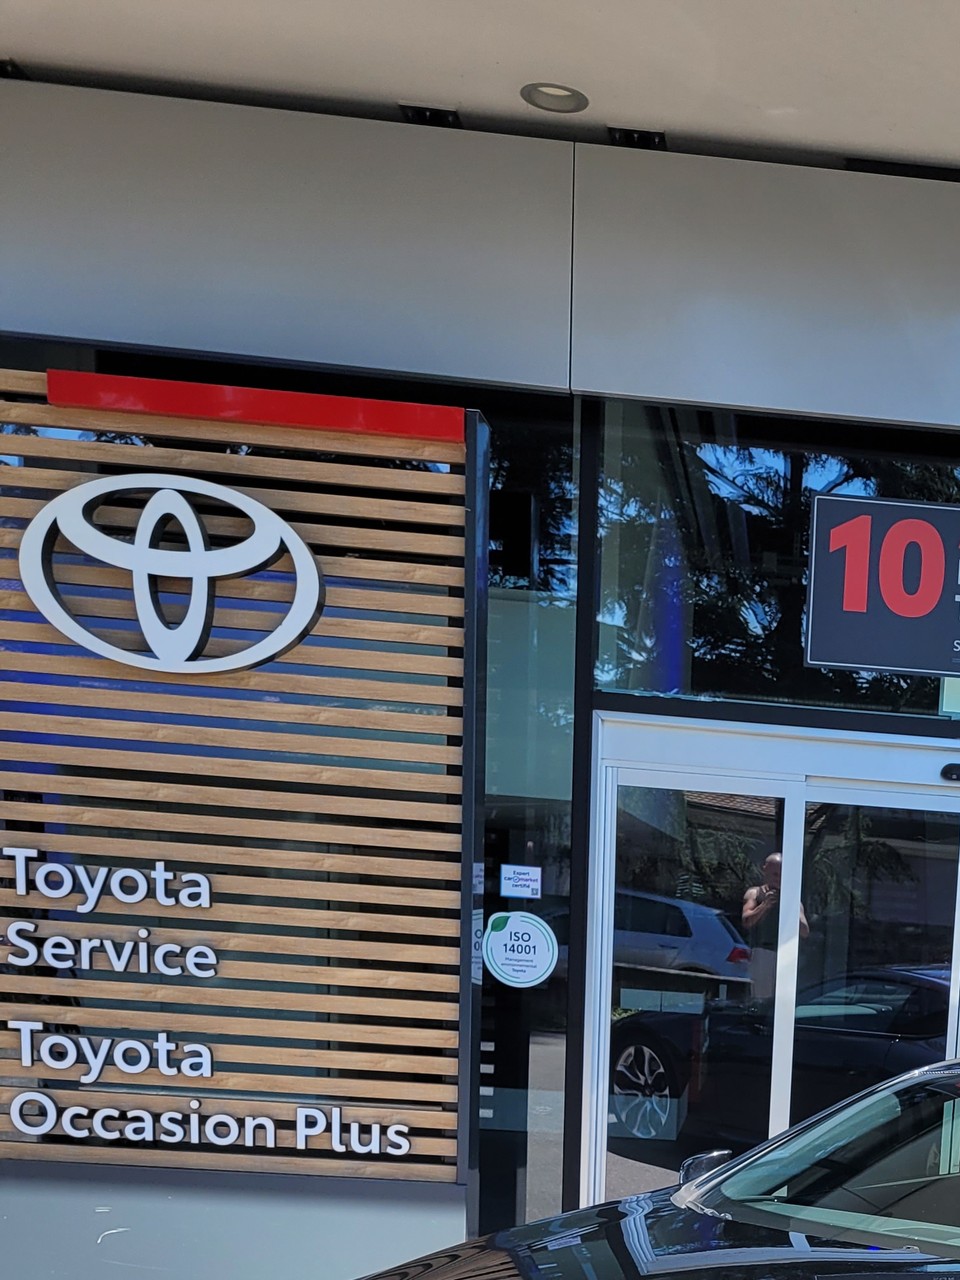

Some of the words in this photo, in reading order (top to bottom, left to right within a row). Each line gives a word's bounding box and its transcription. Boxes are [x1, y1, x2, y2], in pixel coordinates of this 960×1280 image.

[829, 514, 946, 618] 10
[2, 847, 212, 913] Toyota
[6, 921, 218, 978] Service
[503, 943, 537, 956] 14001
[509, 931, 531, 943] ISO
[7, 1020, 213, 1084] Toyota
[9, 1091, 276, 1149] Occasion
[296, 1107, 411, 1157] Plus
